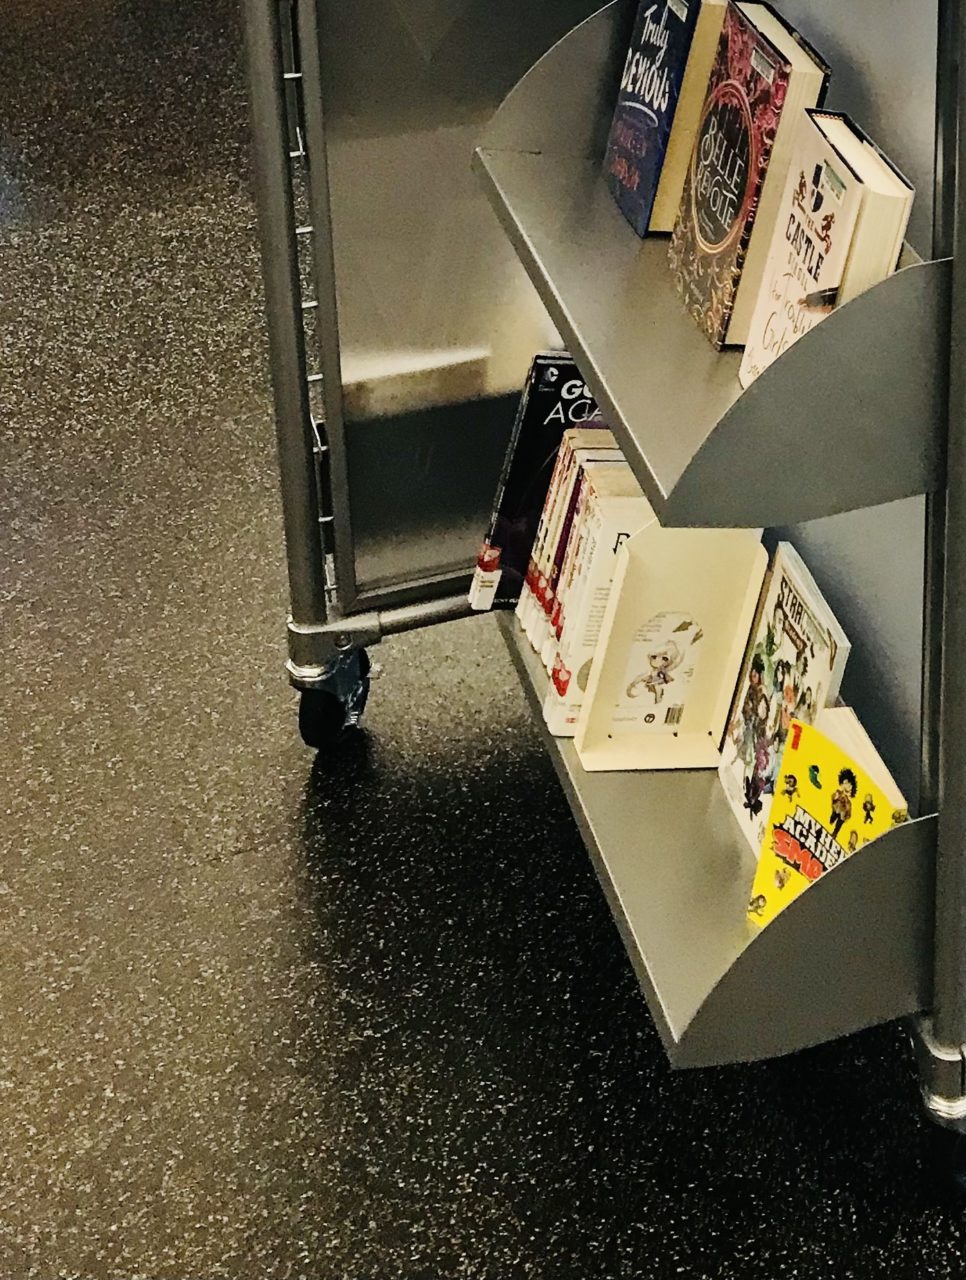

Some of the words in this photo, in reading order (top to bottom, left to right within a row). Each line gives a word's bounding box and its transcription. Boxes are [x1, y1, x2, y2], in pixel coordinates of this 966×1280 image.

[641, 4, 670, 69] Truly
[701, 116, 746, 195] BELLE
[785, 213, 825, 283] CASTLE
[791, 723, 803, 750] 1
[794, 806, 822, 837] MY
